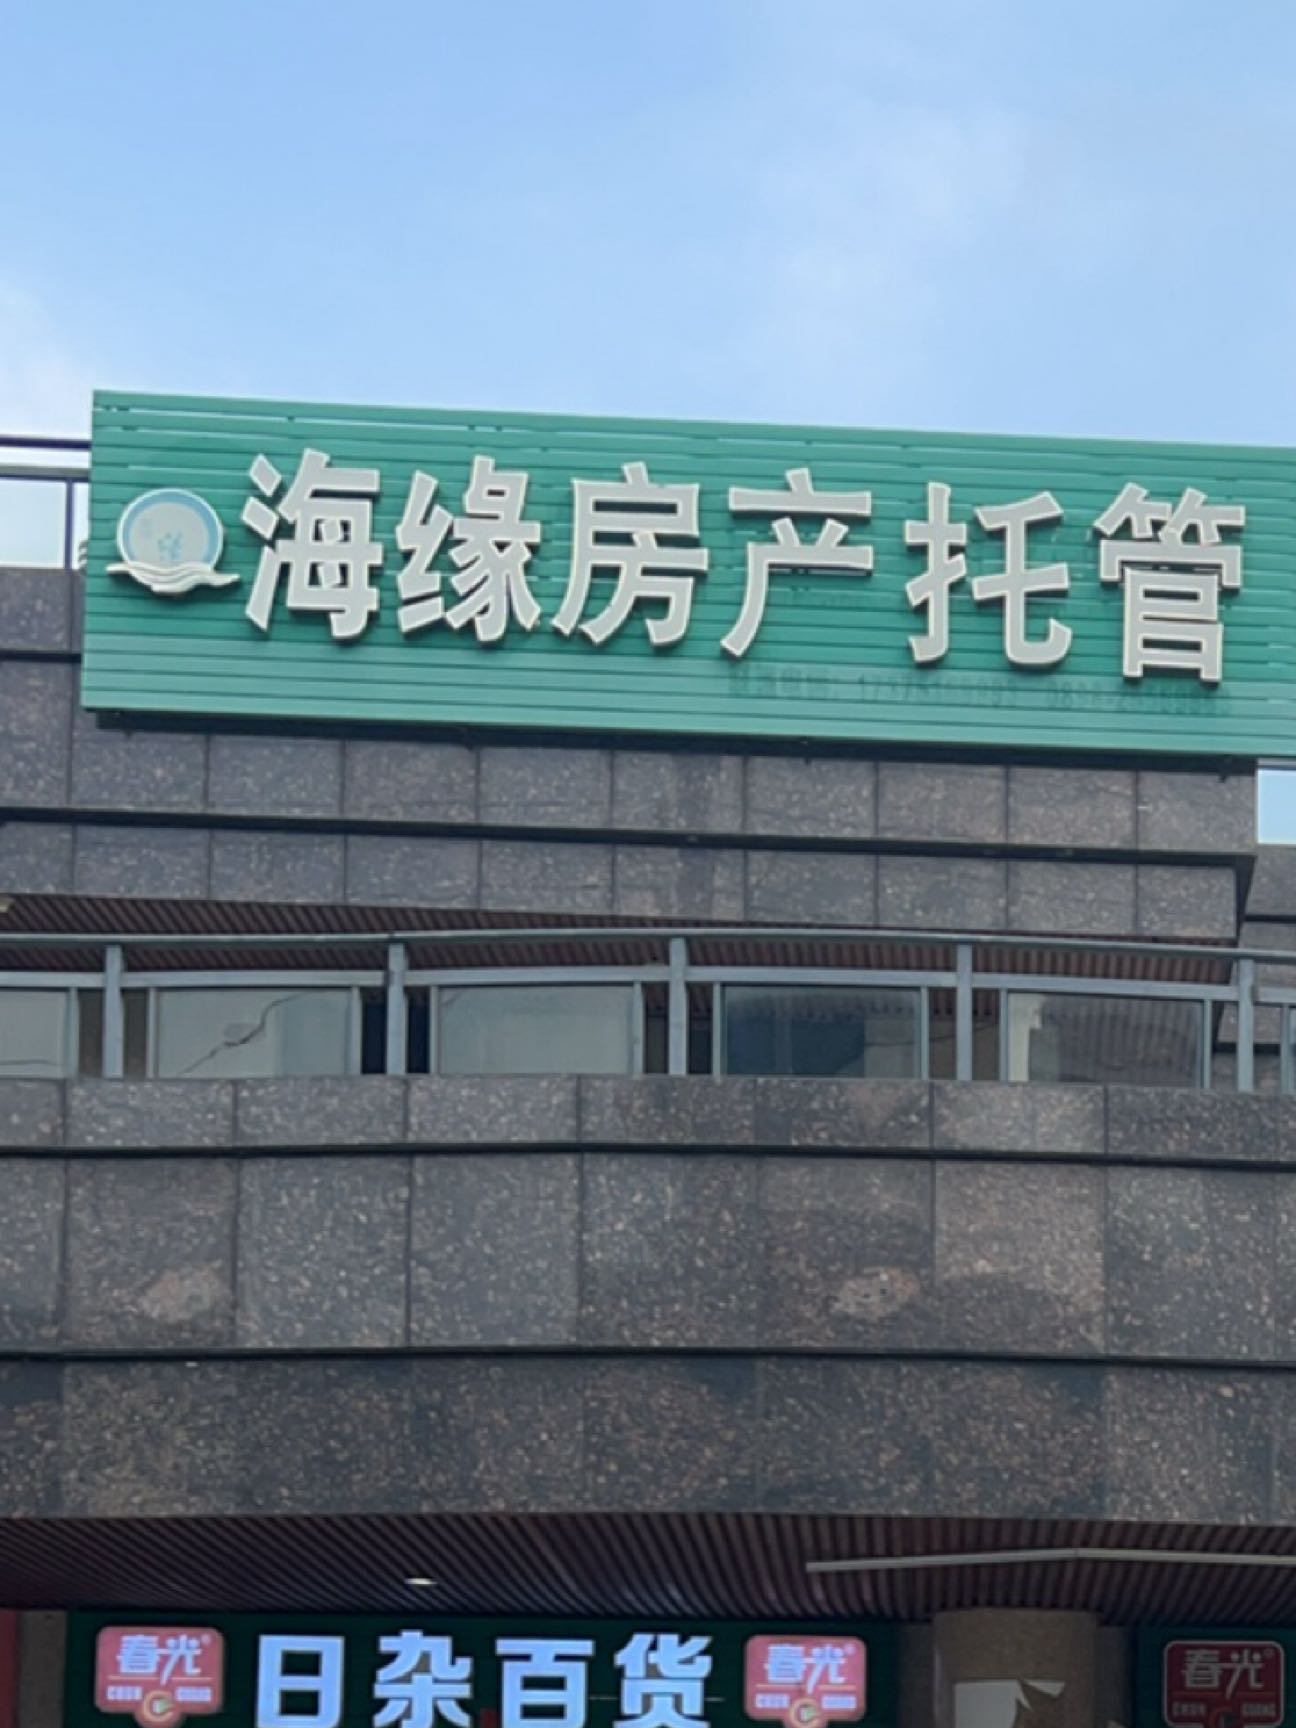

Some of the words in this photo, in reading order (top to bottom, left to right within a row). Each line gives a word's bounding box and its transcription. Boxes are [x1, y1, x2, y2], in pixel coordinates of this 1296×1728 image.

[240, 448, 1246, 684] 海缘房产托管
[116, 1634, 202, 1686] 春光
[764, 1643, 847, 1695] 春光
[1180, 1648, 1264, 1700] 春光
